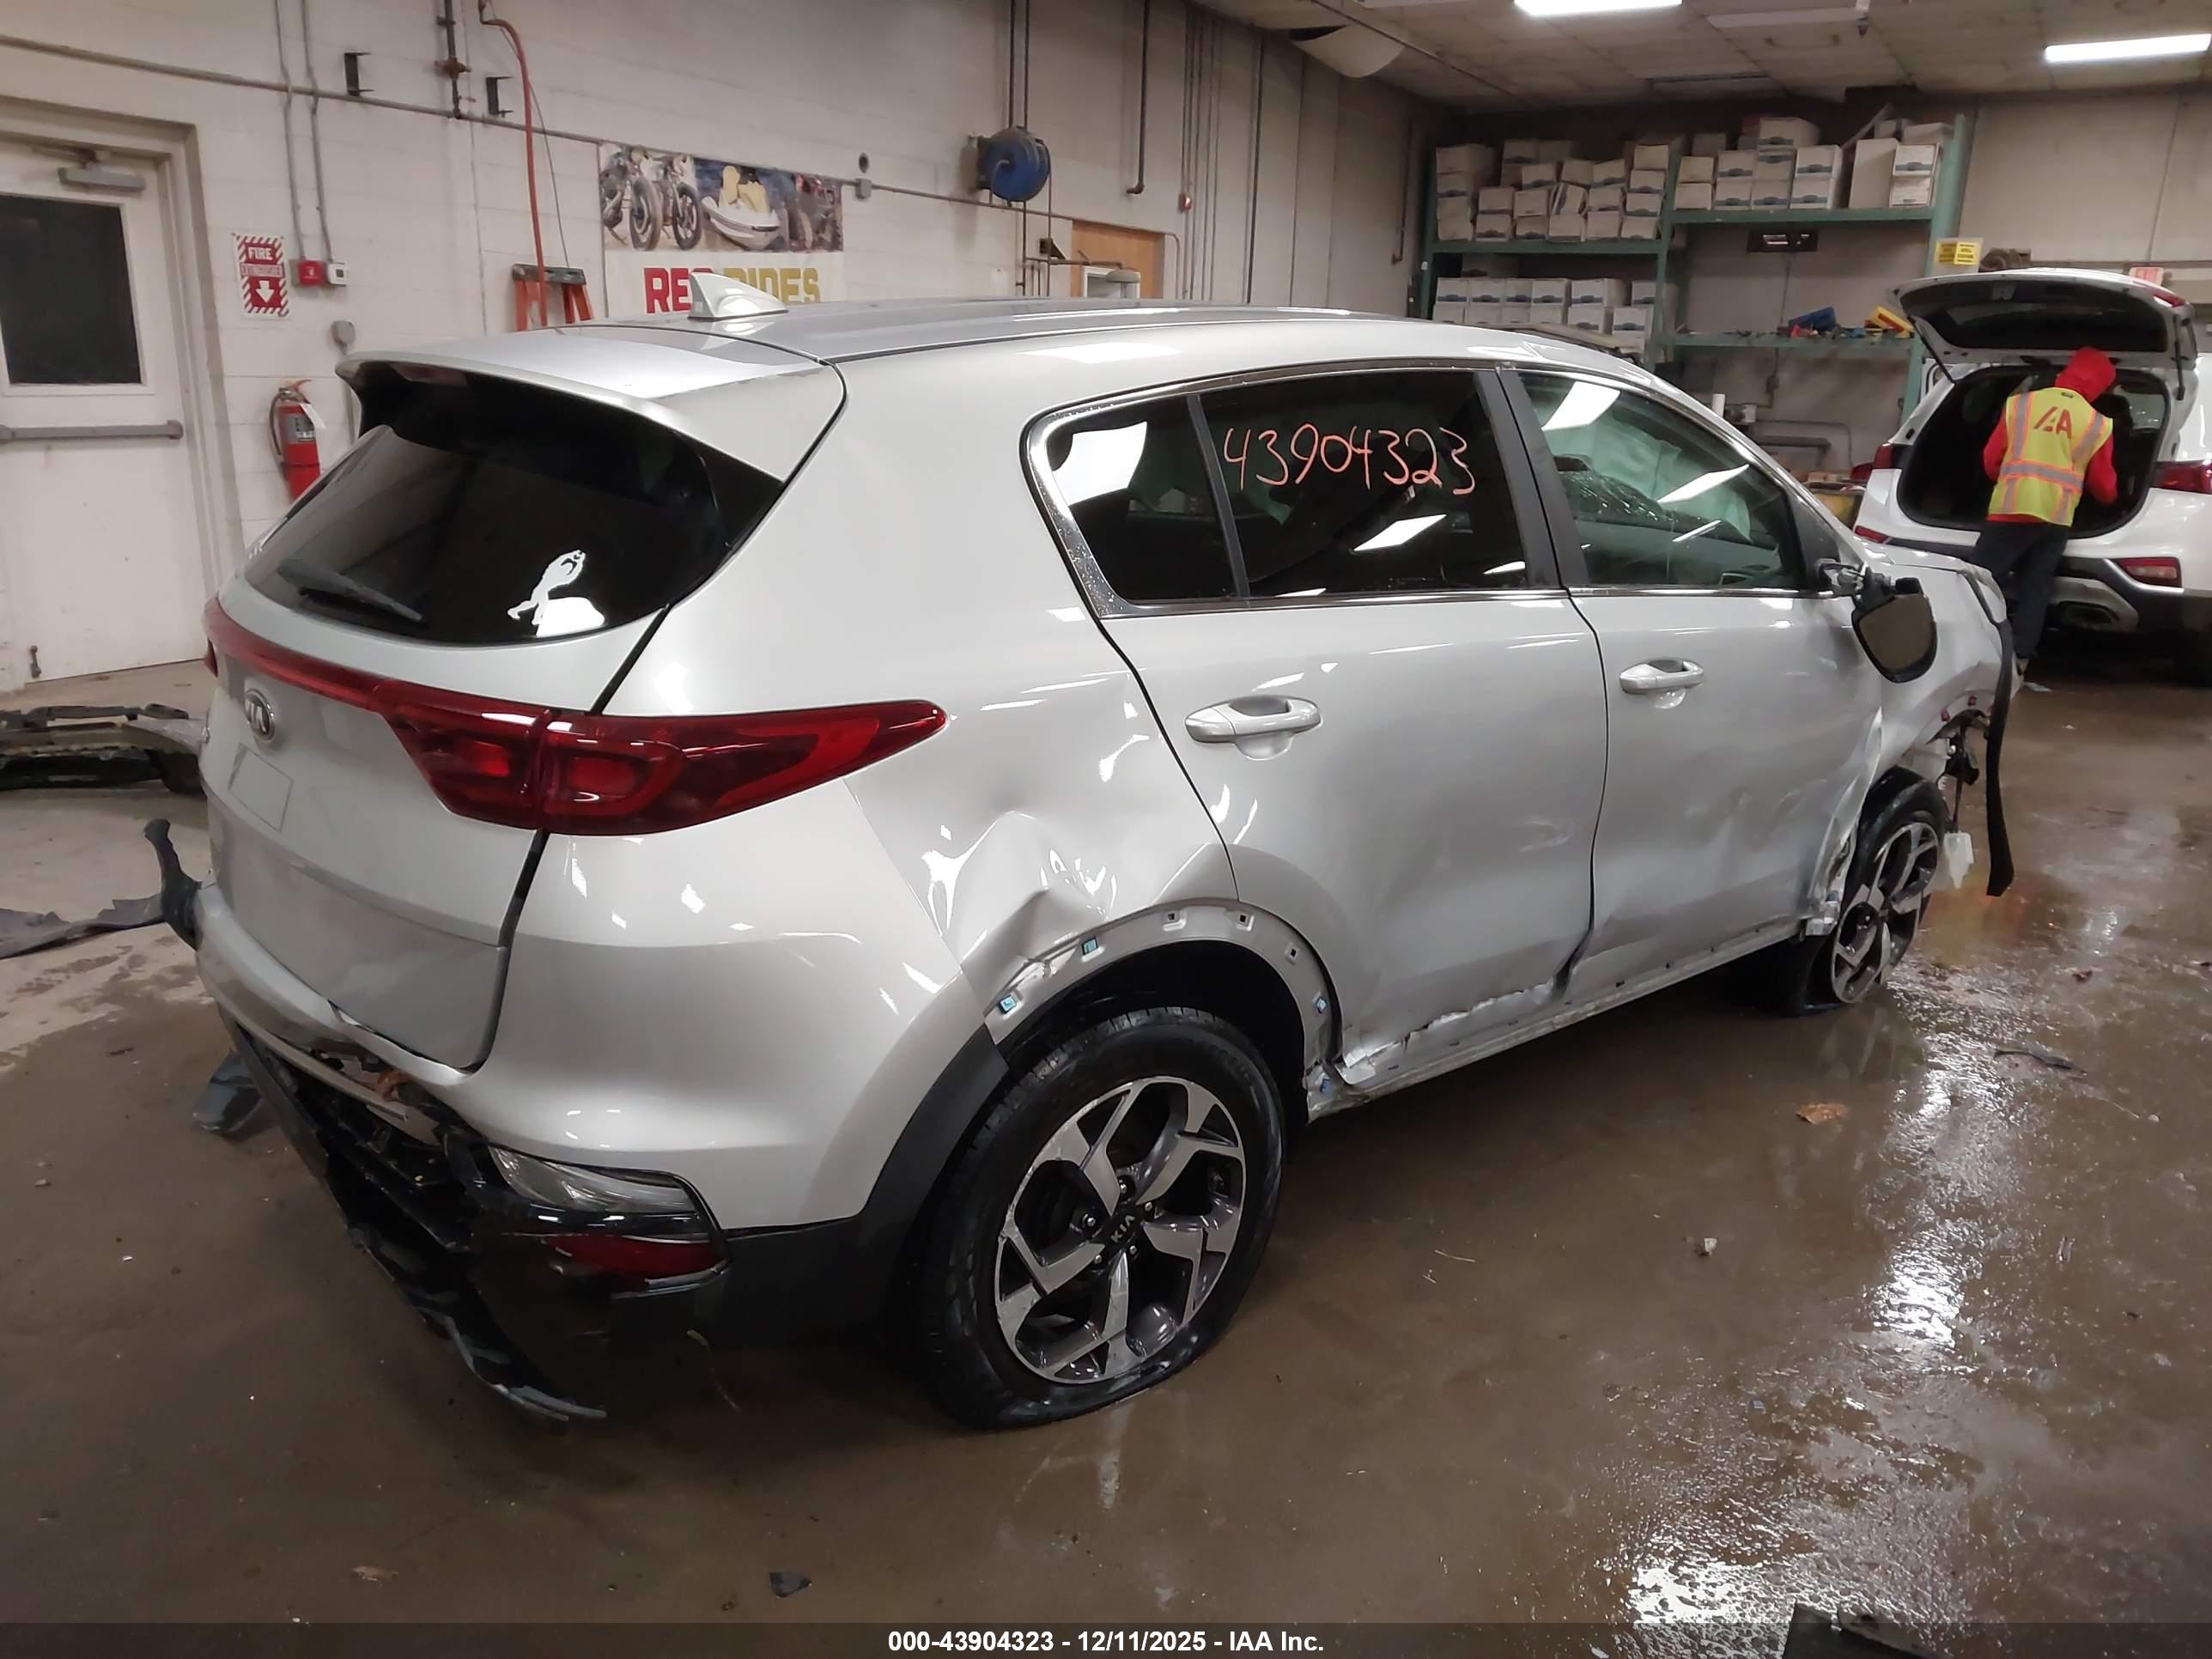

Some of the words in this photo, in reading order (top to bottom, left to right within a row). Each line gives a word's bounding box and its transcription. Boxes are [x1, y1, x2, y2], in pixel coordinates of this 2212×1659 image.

[247, 246, 273, 261] FIRE
[644, 268, 714, 314] RE
[1224, 423, 1475, 495] 43904323
[1110, 1215, 1135, 1243] KIA
